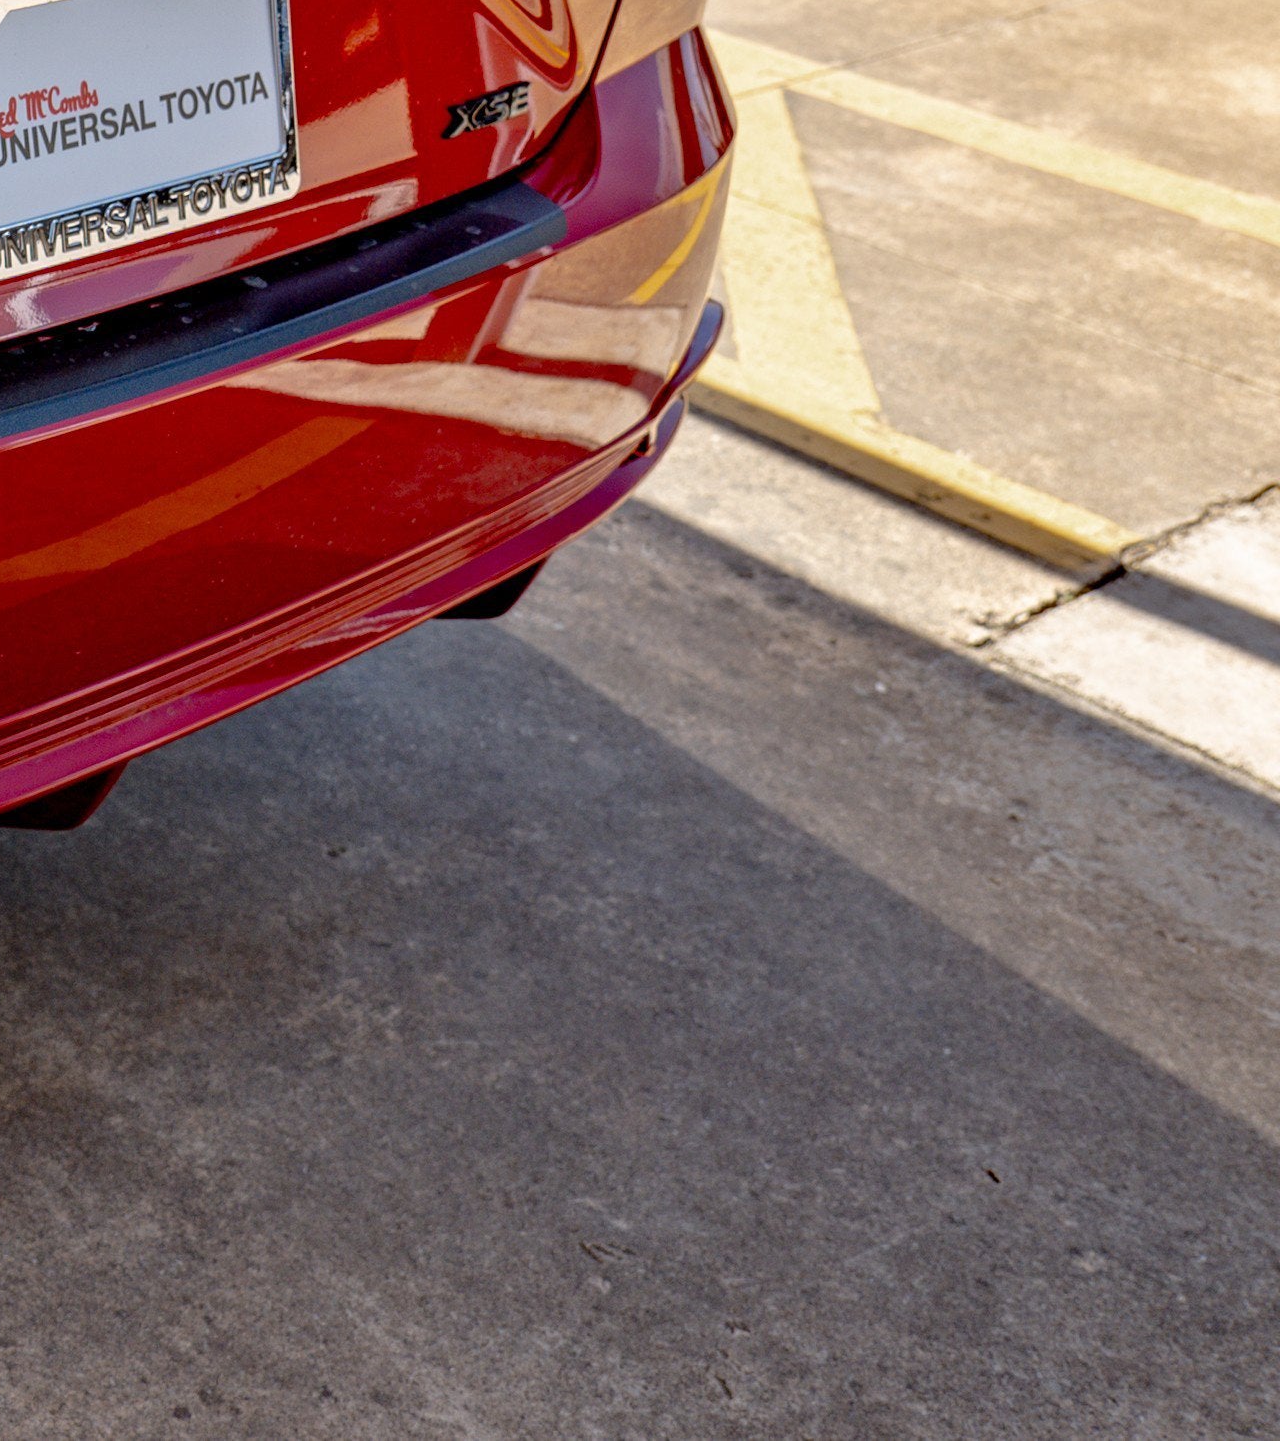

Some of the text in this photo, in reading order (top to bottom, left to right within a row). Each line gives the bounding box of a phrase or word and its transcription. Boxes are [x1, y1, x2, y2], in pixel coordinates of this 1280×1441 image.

[18, 80, 99, 121] McCombs
[160, 71, 269, 124] TOYOTA
[441, 81, 530, 139] XSE
[171, 160, 290, 220] TOYOTA
